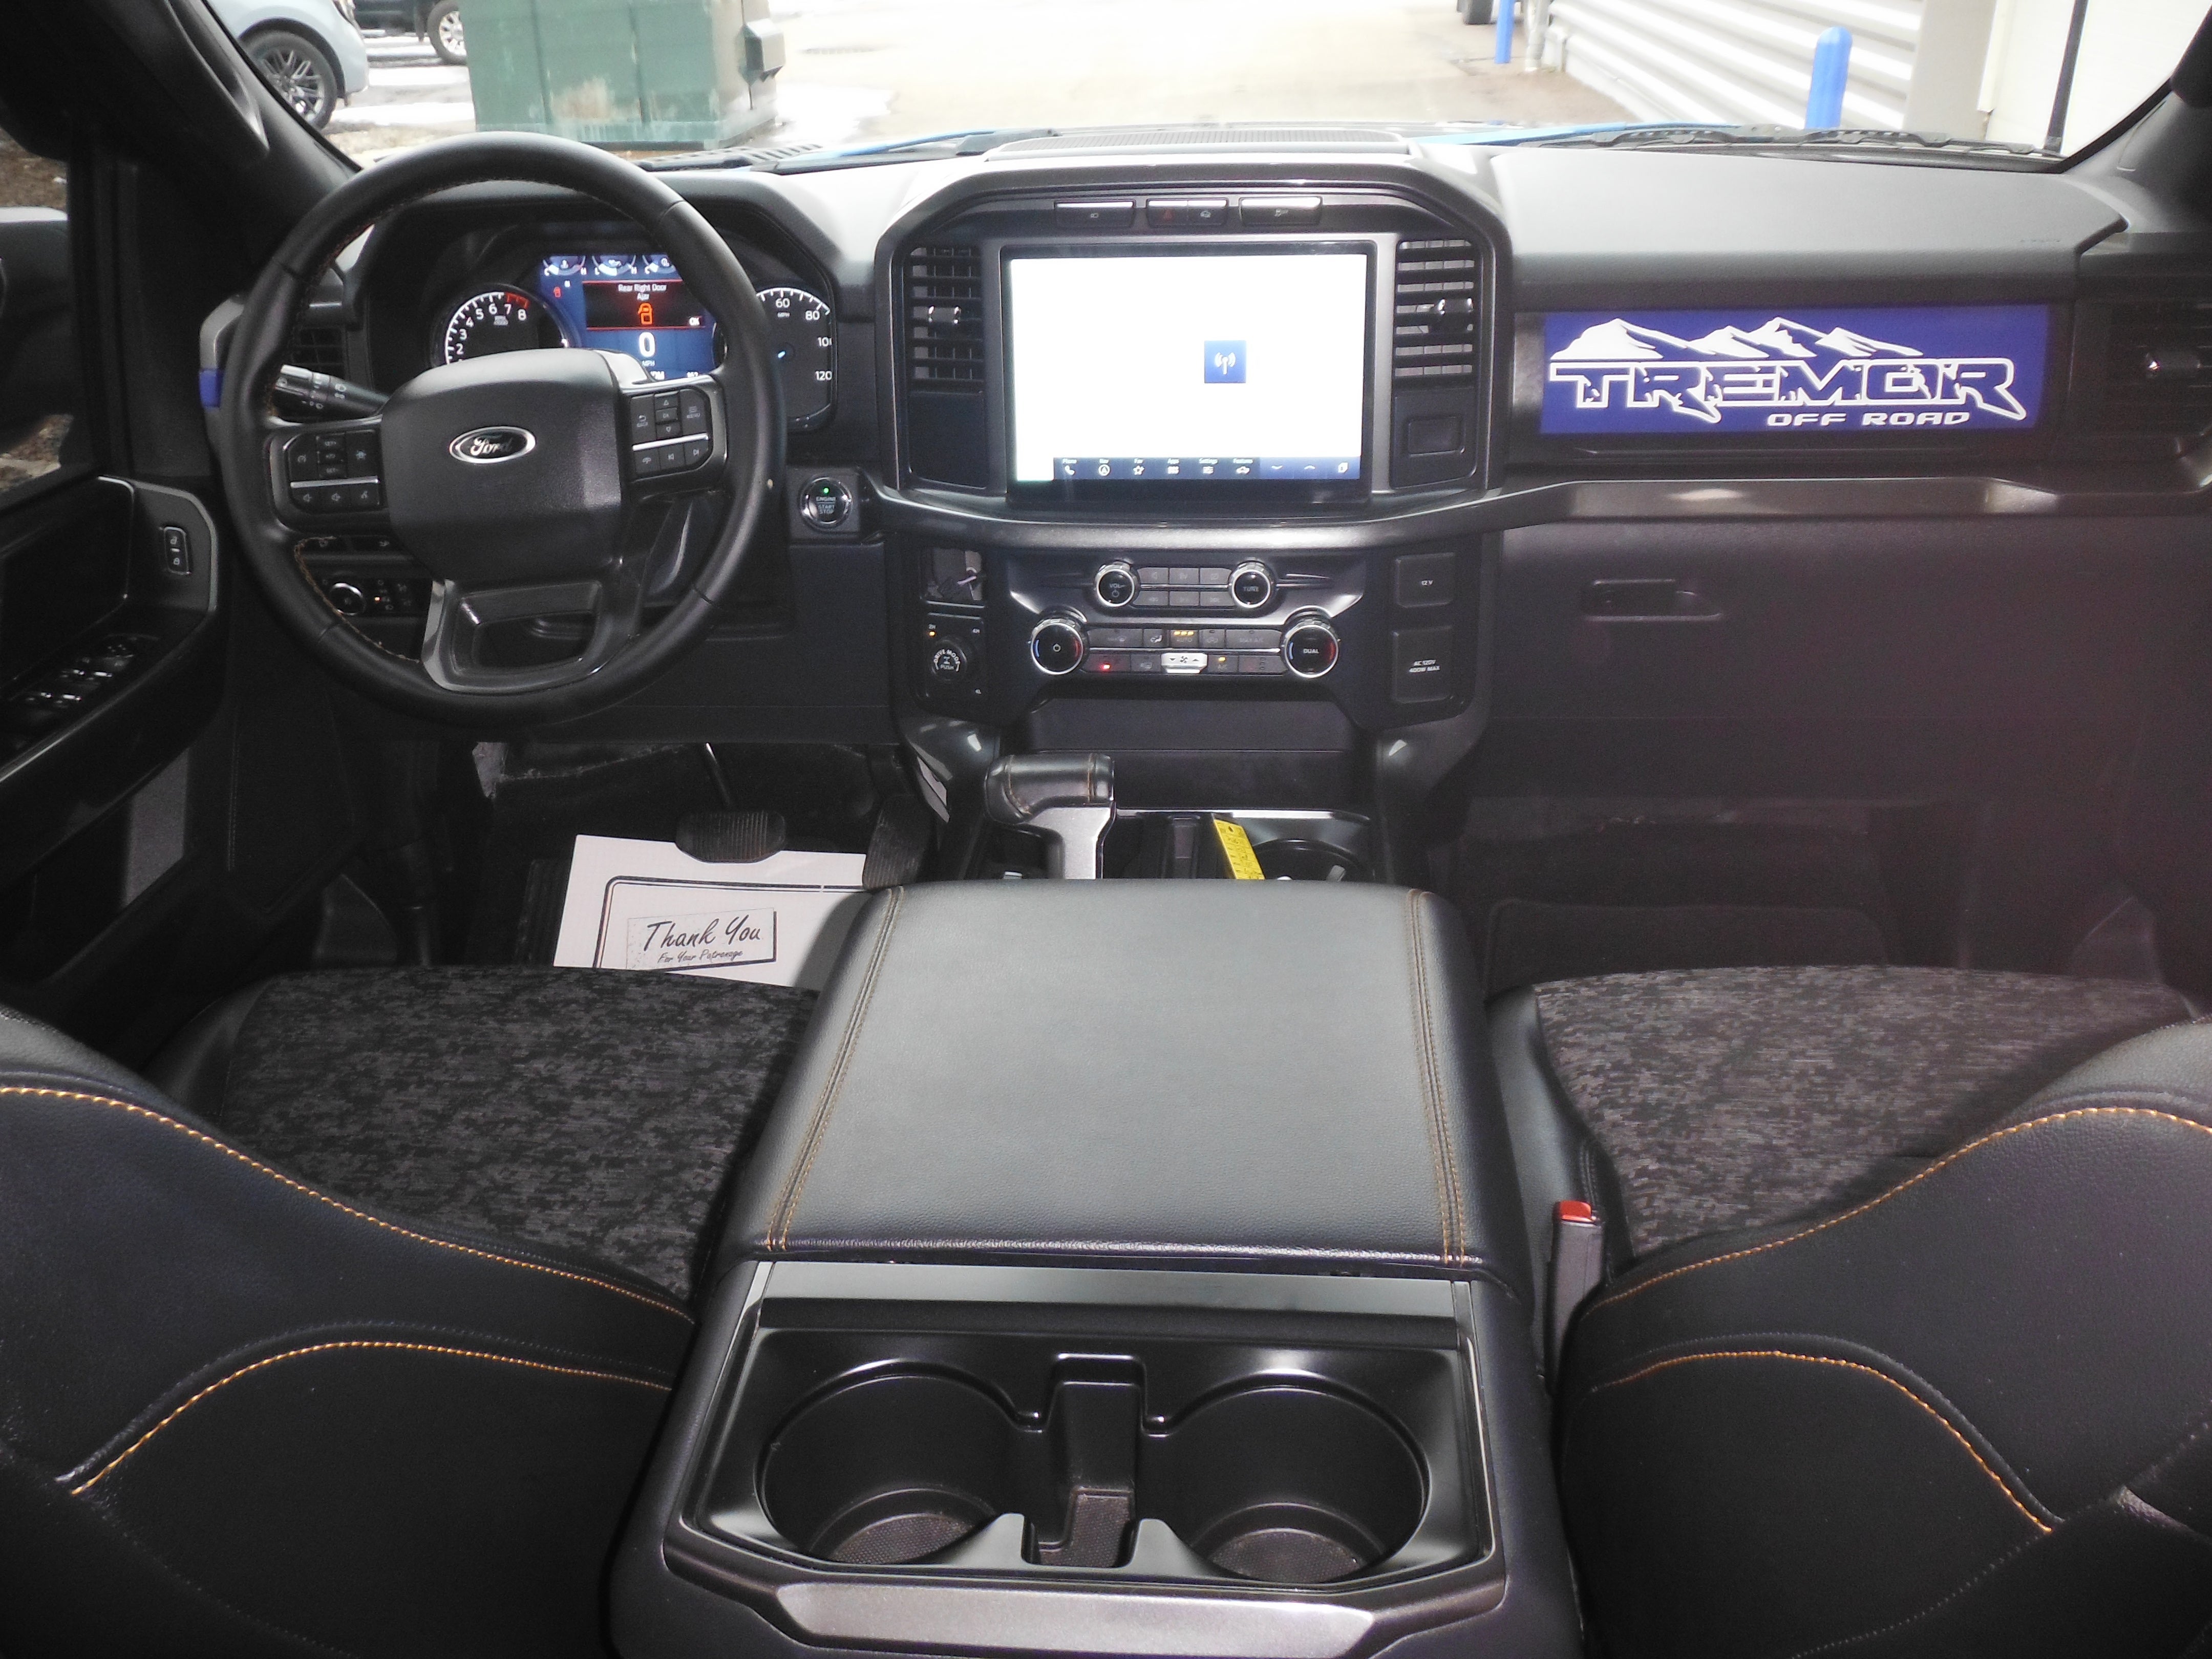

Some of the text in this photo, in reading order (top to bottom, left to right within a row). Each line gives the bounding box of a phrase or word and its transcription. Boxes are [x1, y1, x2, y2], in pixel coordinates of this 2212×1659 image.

[488, 303, 497, 314] 6
[775, 297, 791, 308] 60
[476, 308, 484, 320] 5
[504, 304, 512, 315] 7
[518, 309, 527, 321] 8
[805, 310, 820, 320] 80
[465, 316, 475, 328] 4
[459, 329, 467, 341] 3
[456, 343, 464, 355] 2
[639, 332, 655, 357] 0
[815, 371, 833, 380] 120
[1548, 357, 2027, 423] TREMOR
[1767, 411, 1971, 426] OFF ROAD
[470, 434, 512, 456] Ford
[946, 649, 961, 664] MODE
[643, 914, 761, 951] Thank You
[657, 949, 743, 964] For Your Patronage
